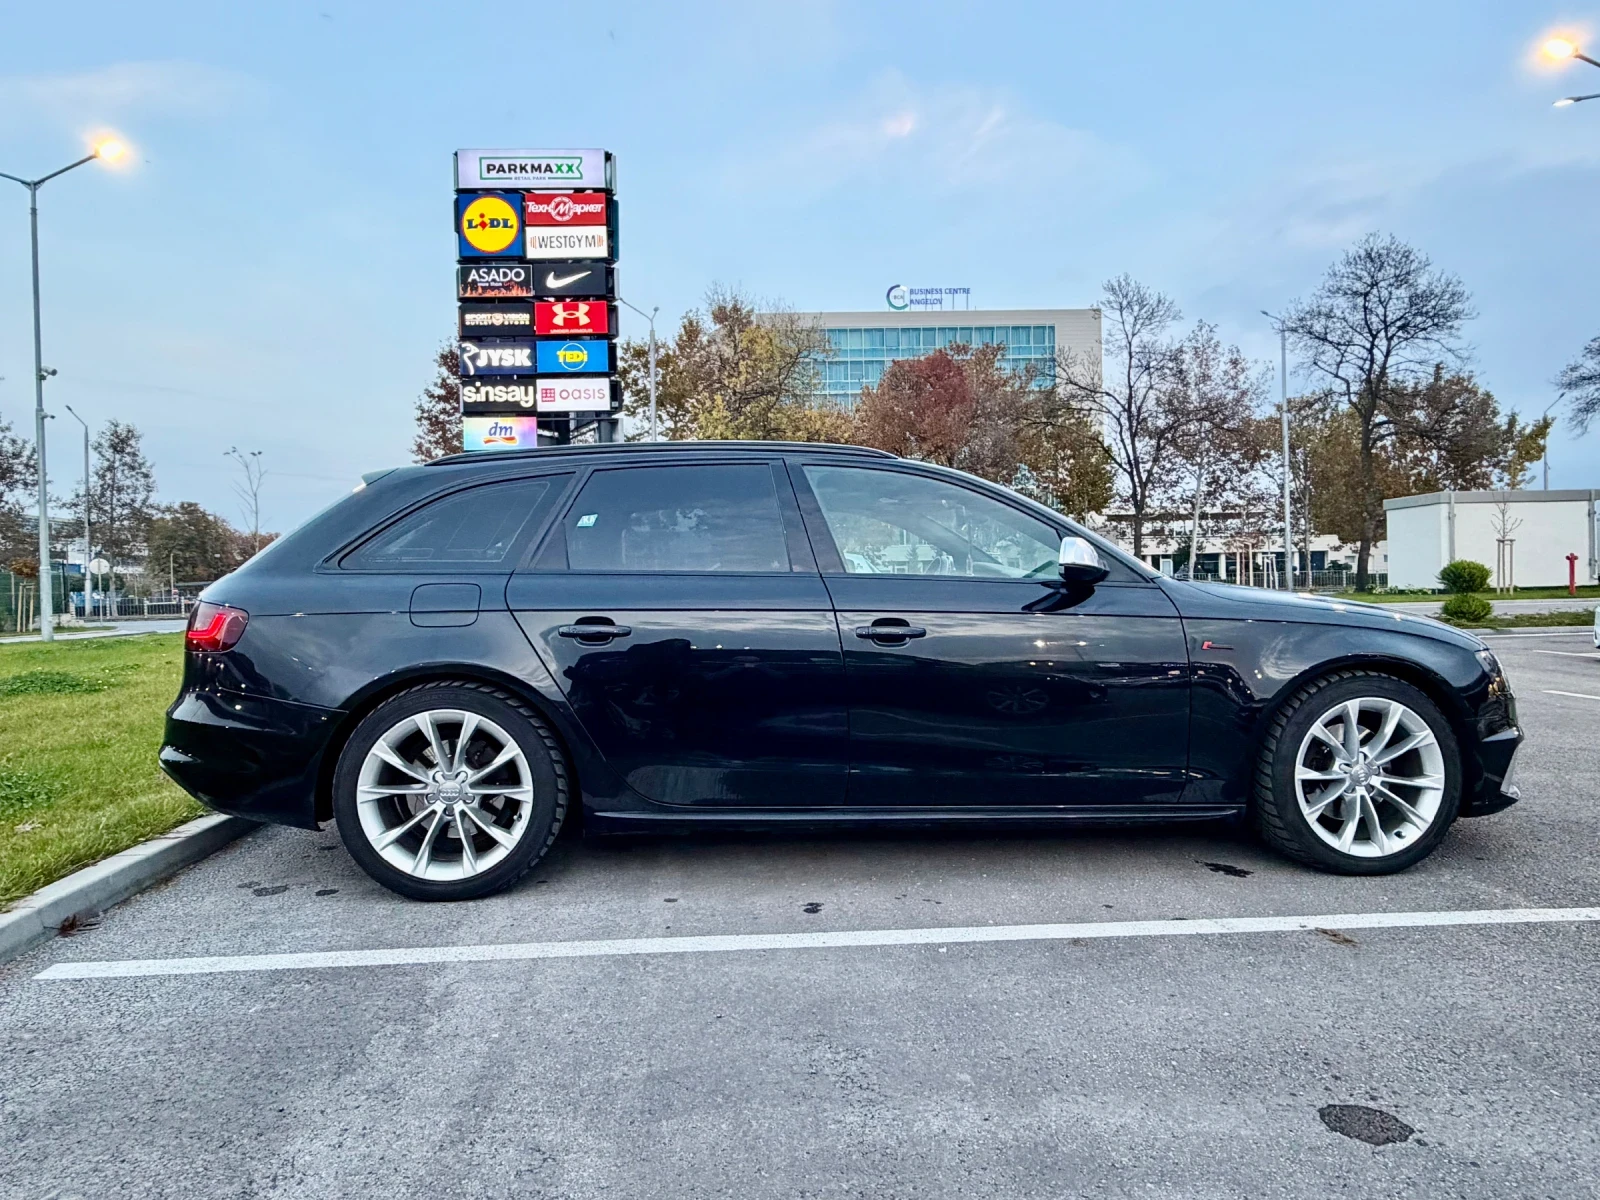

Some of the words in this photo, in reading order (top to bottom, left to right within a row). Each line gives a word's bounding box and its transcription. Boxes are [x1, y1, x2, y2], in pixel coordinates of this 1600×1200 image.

[486, 163, 575, 174] PARKMAXX
[538, 235, 596, 249] WESTGYM
[467, 268, 525, 282] ASADO
[476, 347, 532, 367] JYSK
[559, 387, 606, 400] oasis
[488, 422, 514, 437] dm
